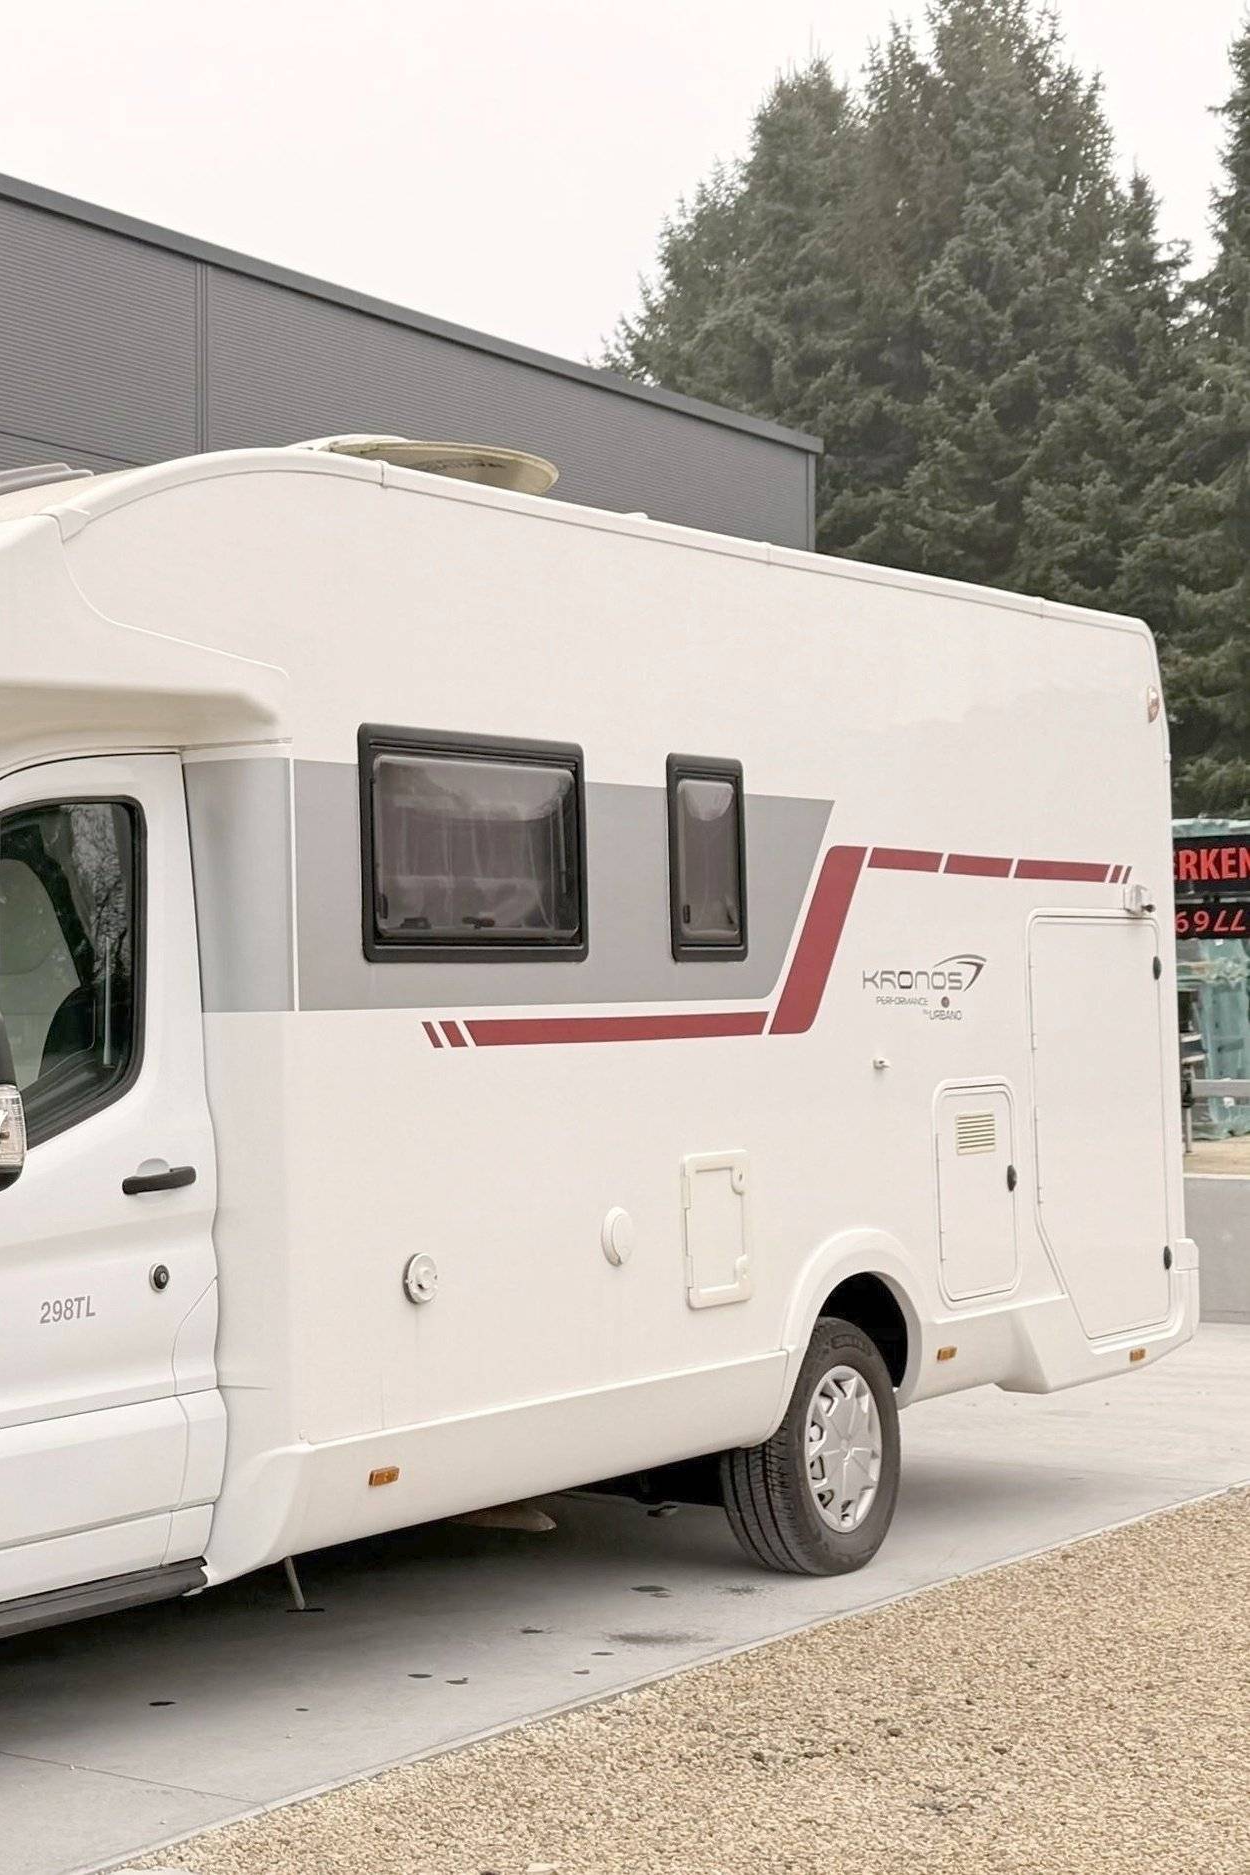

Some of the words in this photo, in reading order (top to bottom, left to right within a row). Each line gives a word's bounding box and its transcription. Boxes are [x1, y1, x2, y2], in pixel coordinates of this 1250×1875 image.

[1173, 847, 1250, 880] RKEN
[862, 969, 963, 990] KRONOS
[876, 995, 929, 1006] PERFORMANCE
[39, 1295, 96, 1324] 298TL
